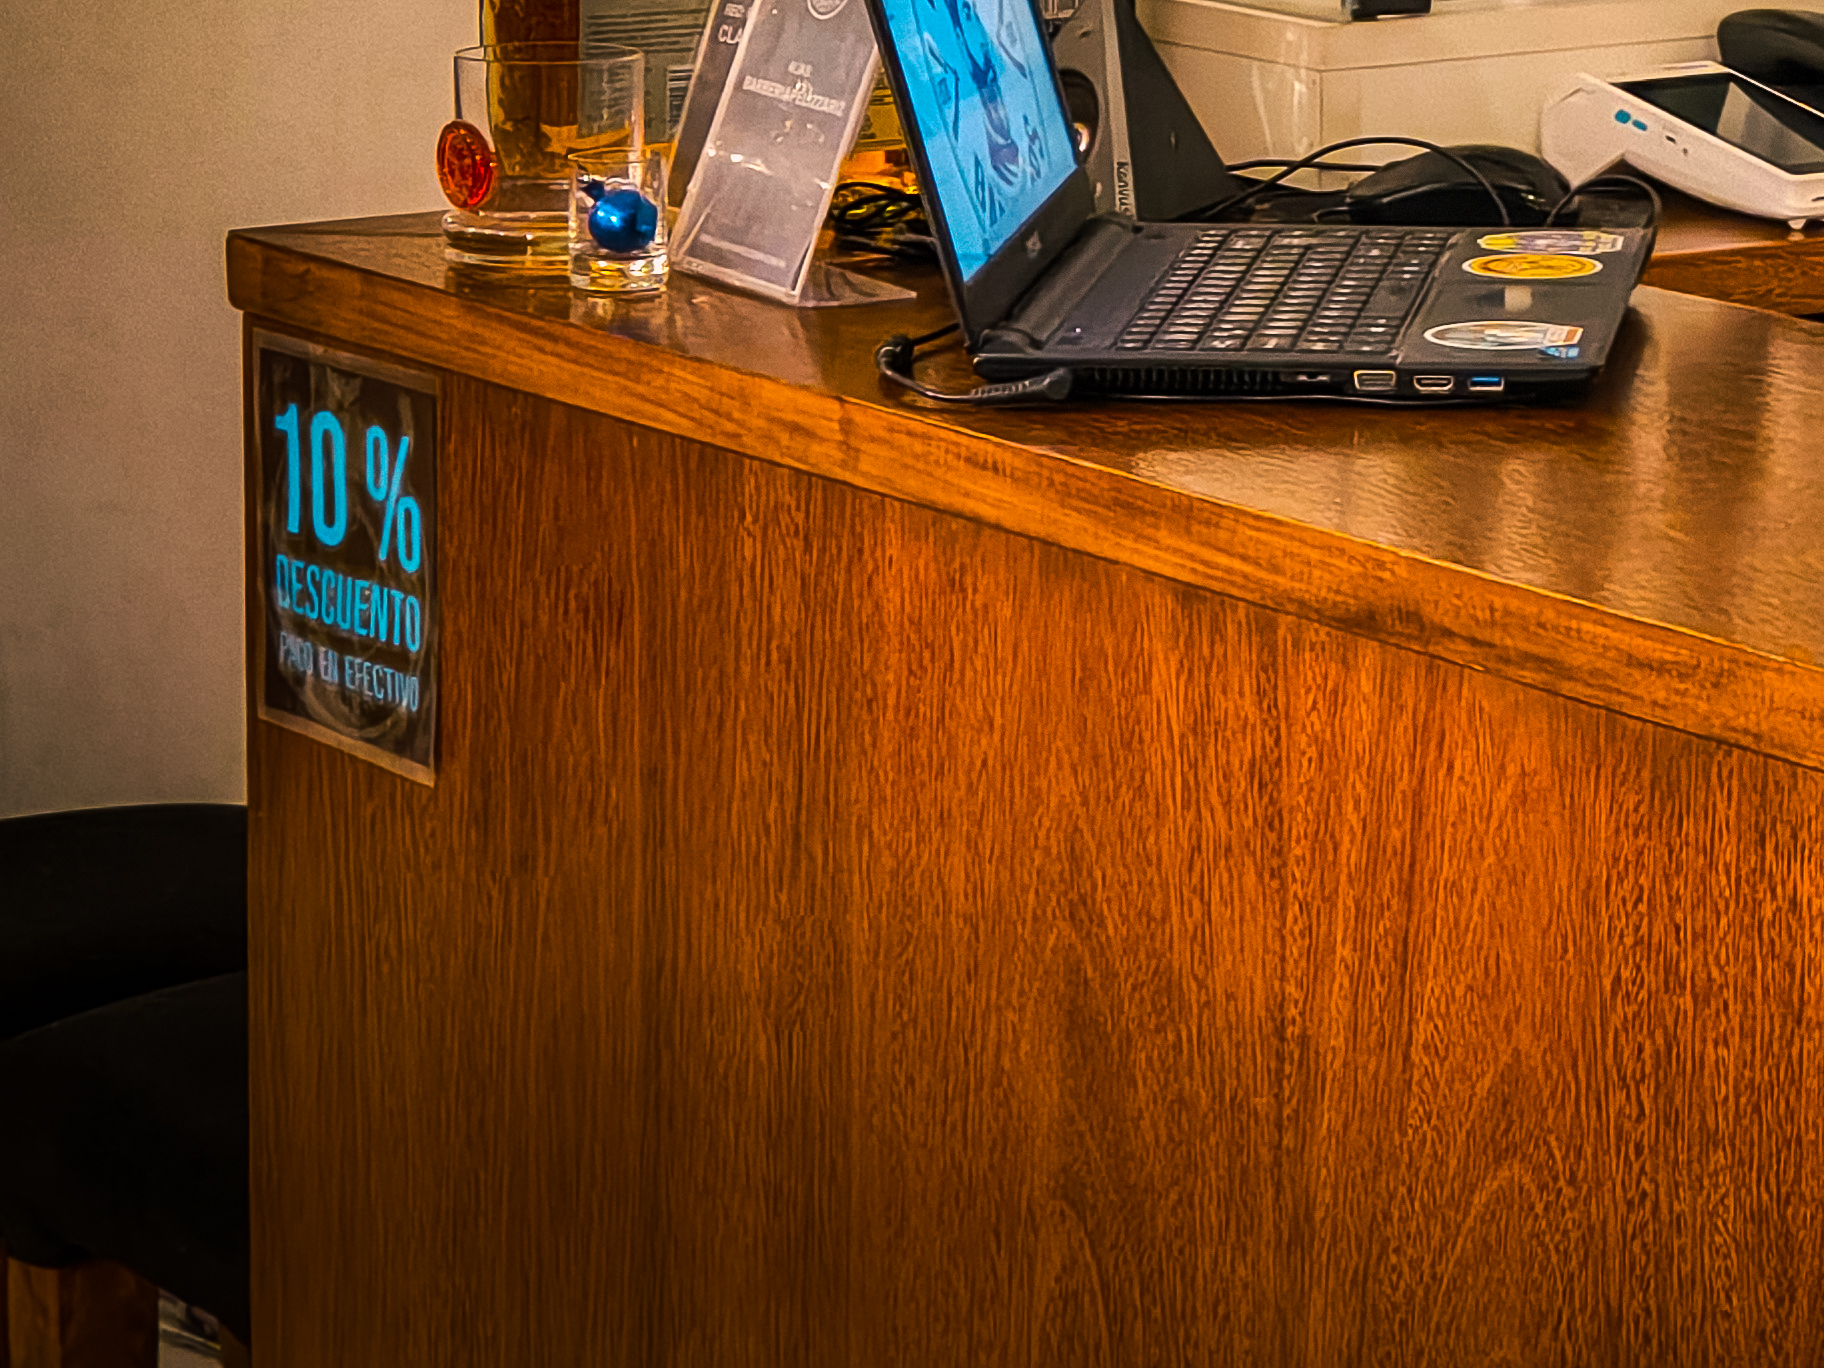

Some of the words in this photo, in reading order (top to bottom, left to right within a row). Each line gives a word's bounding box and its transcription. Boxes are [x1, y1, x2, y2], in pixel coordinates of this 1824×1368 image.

[275, 402, 348, 547] 10
[366, 424, 421, 573] %
[276, 554, 420, 653] DESCUENTO
[319, 645, 339, 684] EN
[345, 655, 419, 713] EFECTIVO
